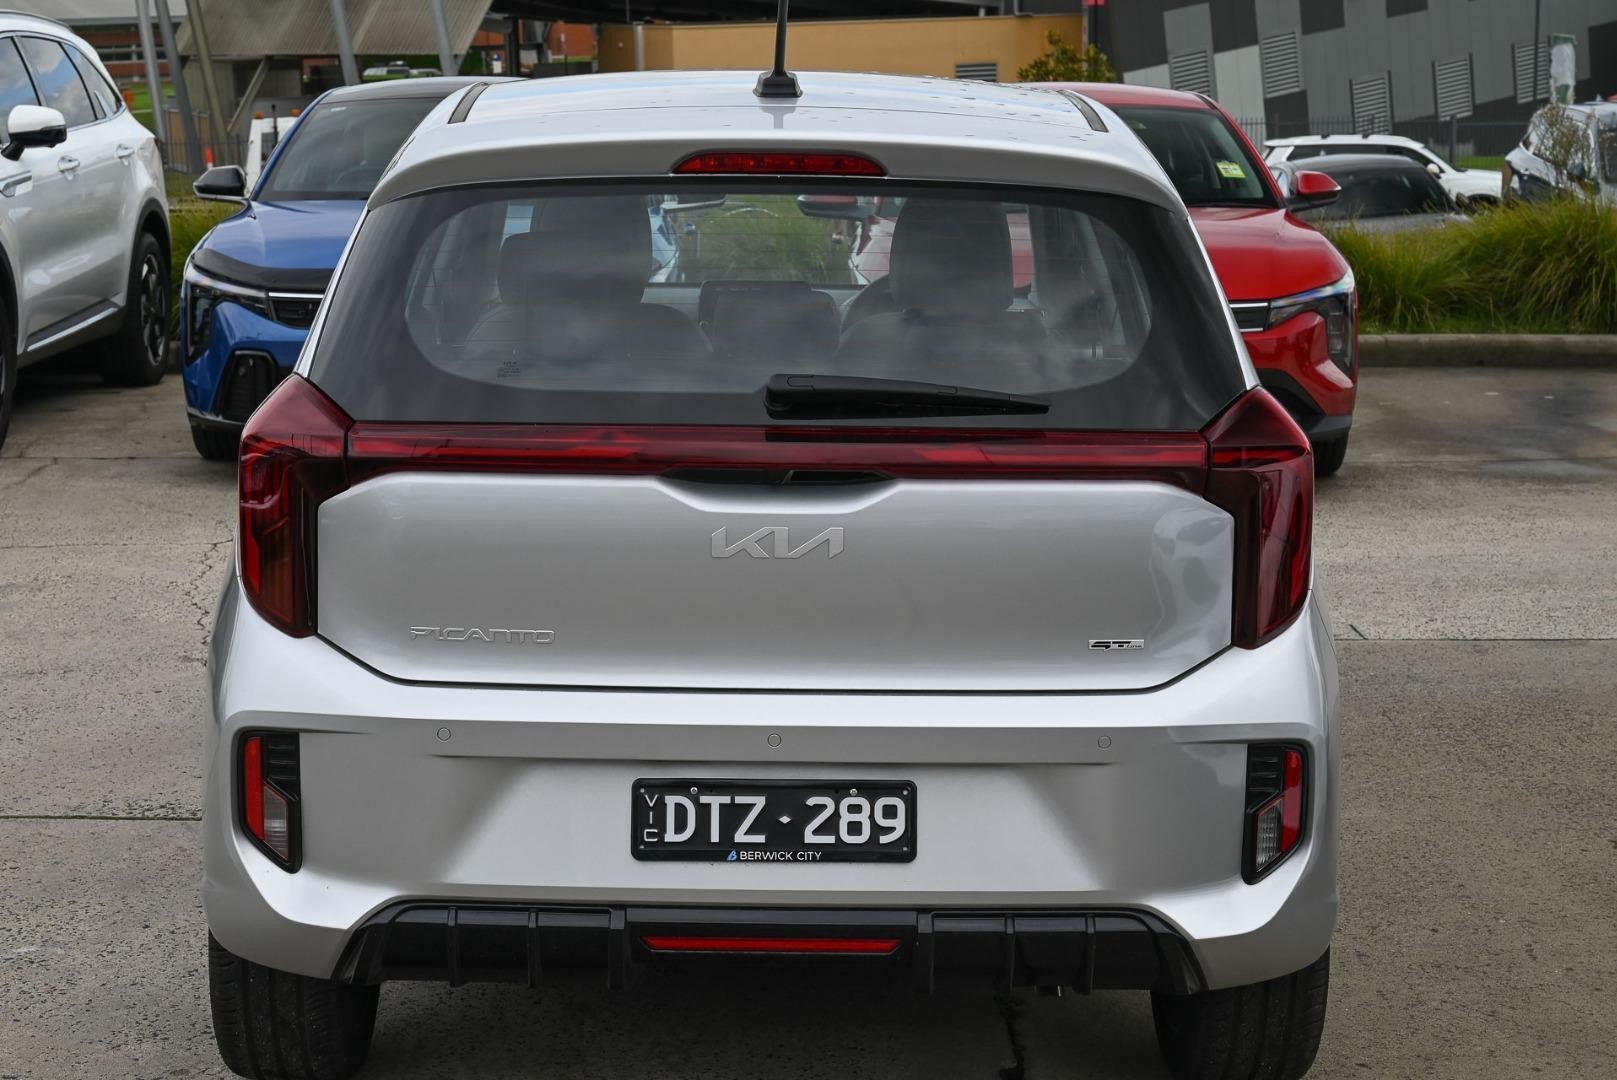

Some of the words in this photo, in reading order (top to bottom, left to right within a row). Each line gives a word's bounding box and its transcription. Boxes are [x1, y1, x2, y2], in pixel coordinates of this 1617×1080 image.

[711, 526, 845, 560] KIA
[409, 626, 556, 644] PICANTO
[643, 794, 659, 842] VIC
[664, 795, 766, 843] DTZ
[804, 796, 906, 844] 289
[739, 851, 794, 861] BERWICK
[796, 851, 822, 861] CITY
